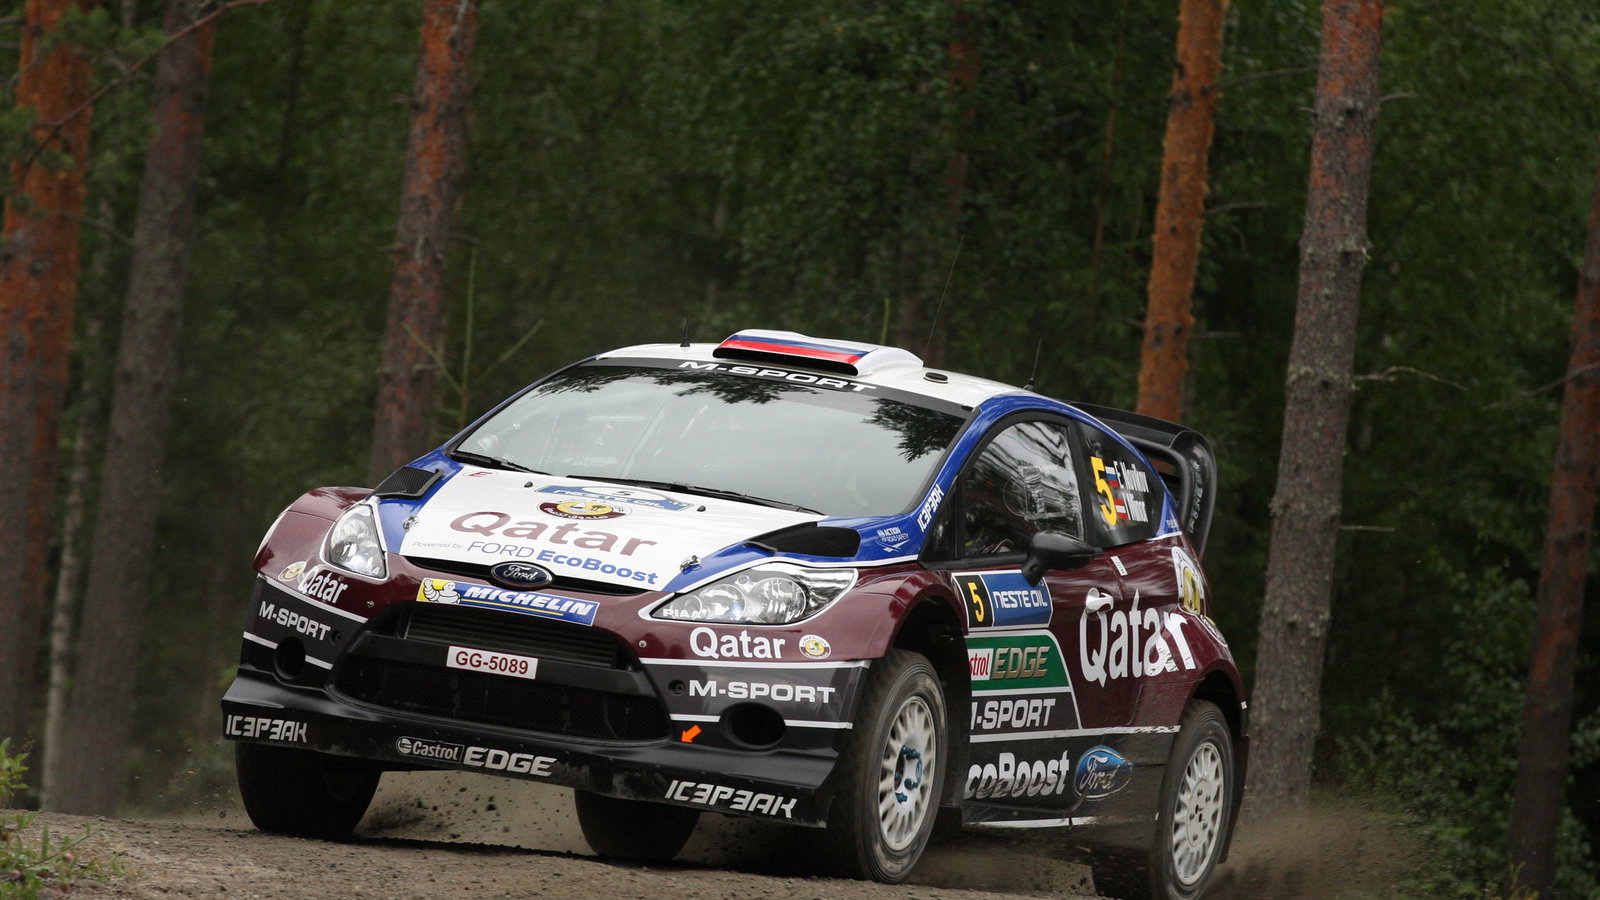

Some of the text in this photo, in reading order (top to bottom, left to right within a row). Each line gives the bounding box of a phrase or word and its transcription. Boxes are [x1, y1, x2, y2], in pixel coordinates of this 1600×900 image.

[678, 361, 877, 393] M-SPORT
[1090, 456, 1117, 526] 5
[450, 511, 658, 557] Qatar
[412, 541, 451, 549] Powered
[467, 541, 535, 558] FORD
[536, 549, 659, 585] EcoBoost
[503, 564, 539, 581] Ford
[297, 564, 349, 604] Qatar
[463, 586, 594, 616] MICHELIN
[967, 582, 985, 622] 5
[992, 589, 1048, 609] NESTE OIL
[259, 600, 332, 641] M-SPORT
[1079, 587, 1197, 688] Qatar
[690, 626, 786, 660] Qatar
[455, 651, 529, 675] GG-5089
[969, 646, 1051, 679] strol EDGE
[689, 679, 836, 704] M-SPORT
[412, 740, 558, 777] Castrol EDGE
[963, 749, 1070, 800] coBoost
[1079, 754, 1121, 790] Ford
